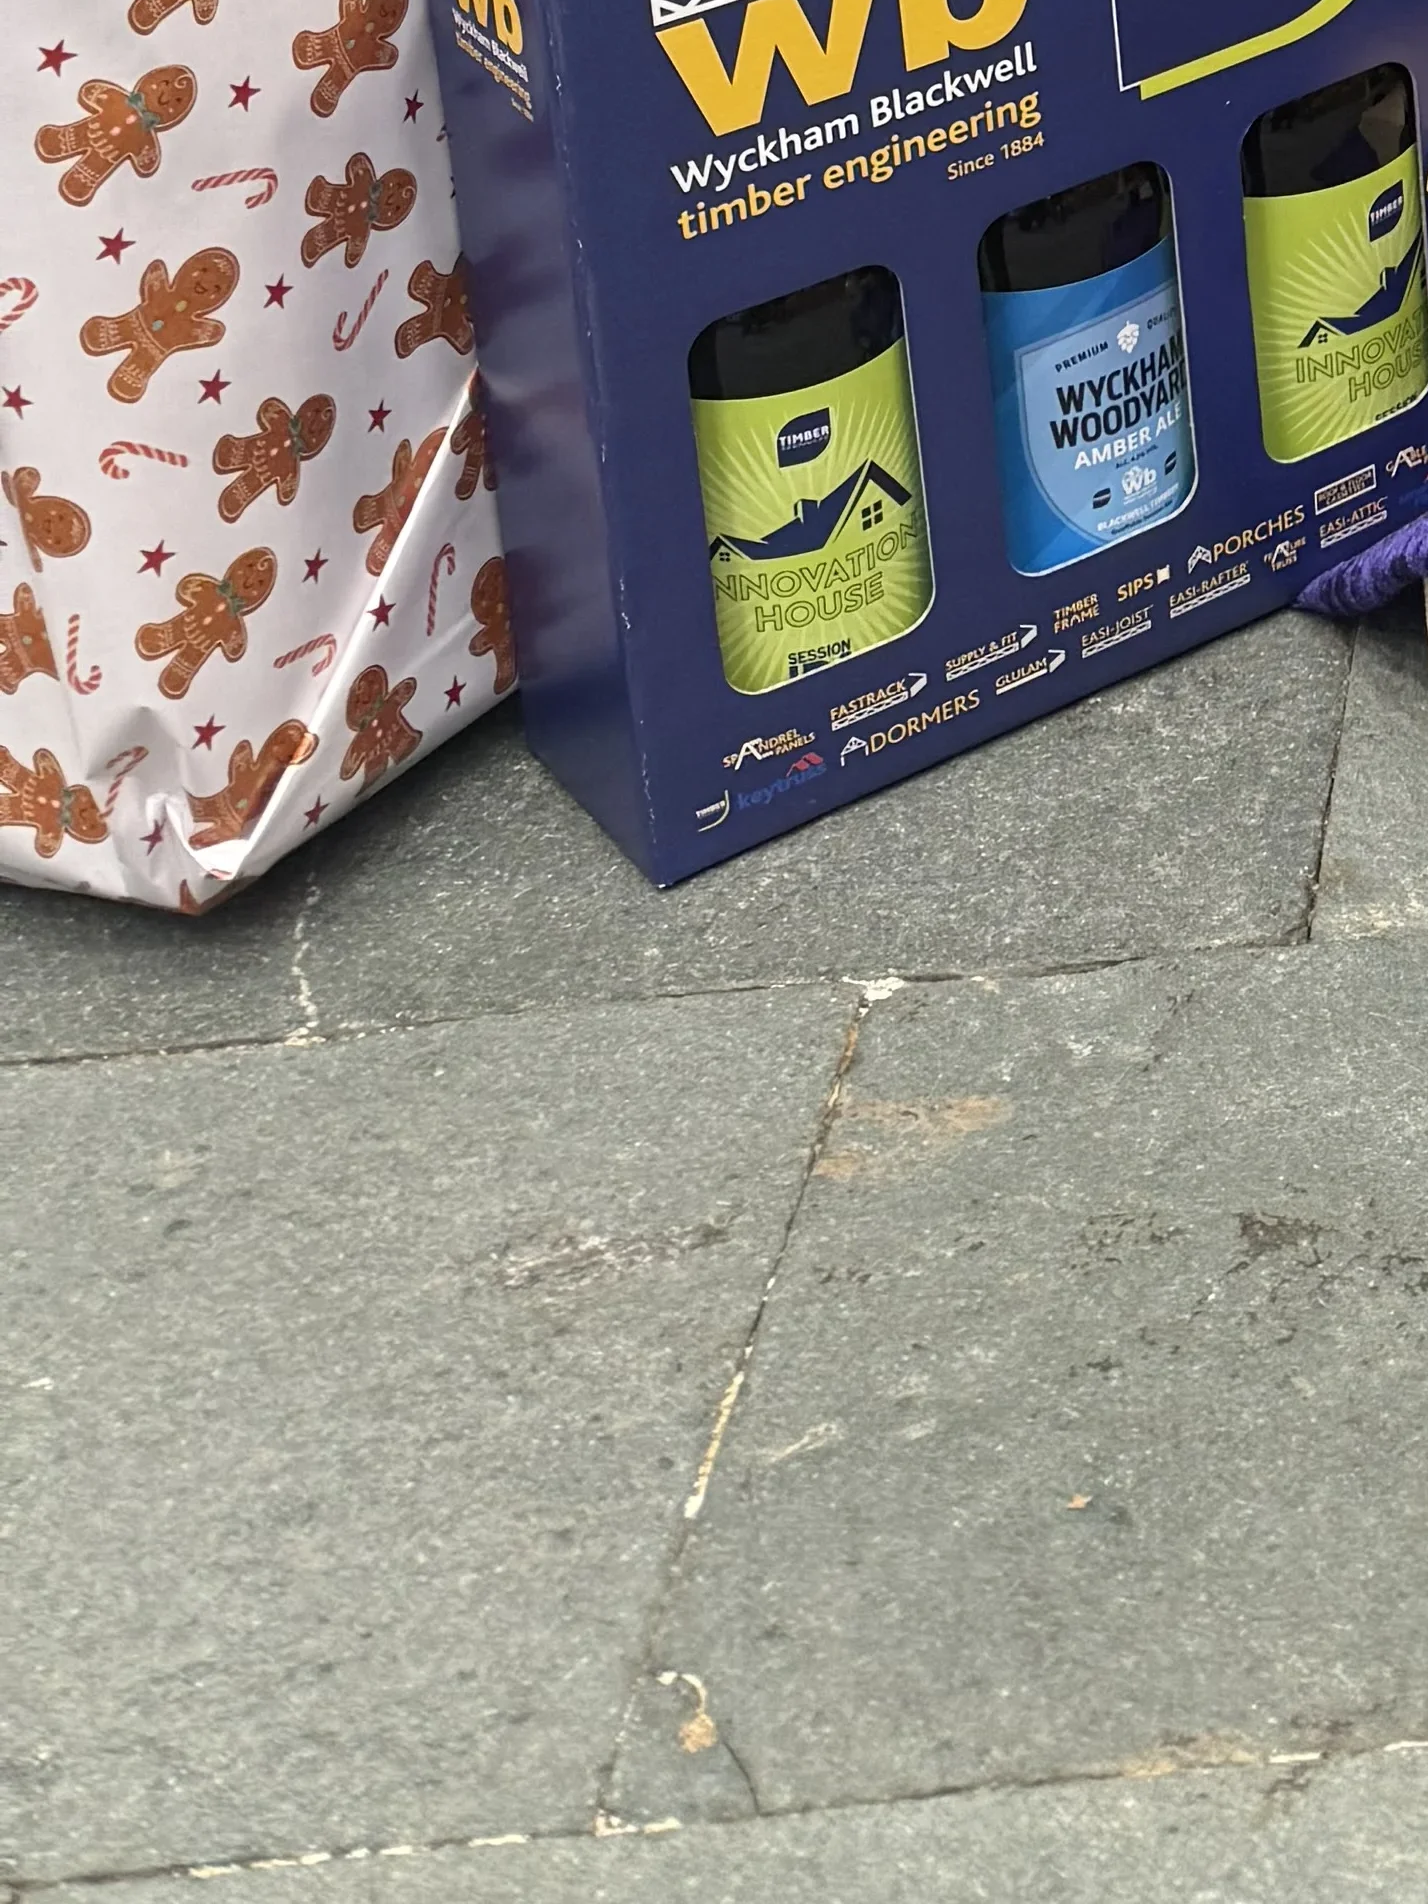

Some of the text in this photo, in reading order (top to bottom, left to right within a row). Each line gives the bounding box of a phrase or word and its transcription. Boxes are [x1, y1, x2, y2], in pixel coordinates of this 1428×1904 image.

[670, 41, 1038, 195] Wyckham Blackwell
[677, 90, 1043, 241] timber engineering
[946, 130, 1045, 182] Since 1884
[1054, 341, 1109, 373] PREMIUM
[779, 424, 831, 448] TIMBER
[1074, 426, 1152, 470] AMBER
[1155, 402, 1183, 437] ALE
[1211, 504, 1306, 563] PORCHES
[1318, 497, 1387, 538] EASI-ATTIC
[755, 571, 885, 633] HOUSE
[1117, 572, 1154, 603] SIPS
[1168, 563, 1249, 608] EASI-RAFTER
[1080, 605, 1151, 648] EASI-JOIST
[788, 638, 851, 665] SESSION
[995, 656, 1048, 689] GLULAM
[830, 678, 906, 721] FASTRACK
[869, 688, 981, 754] DORMERS
